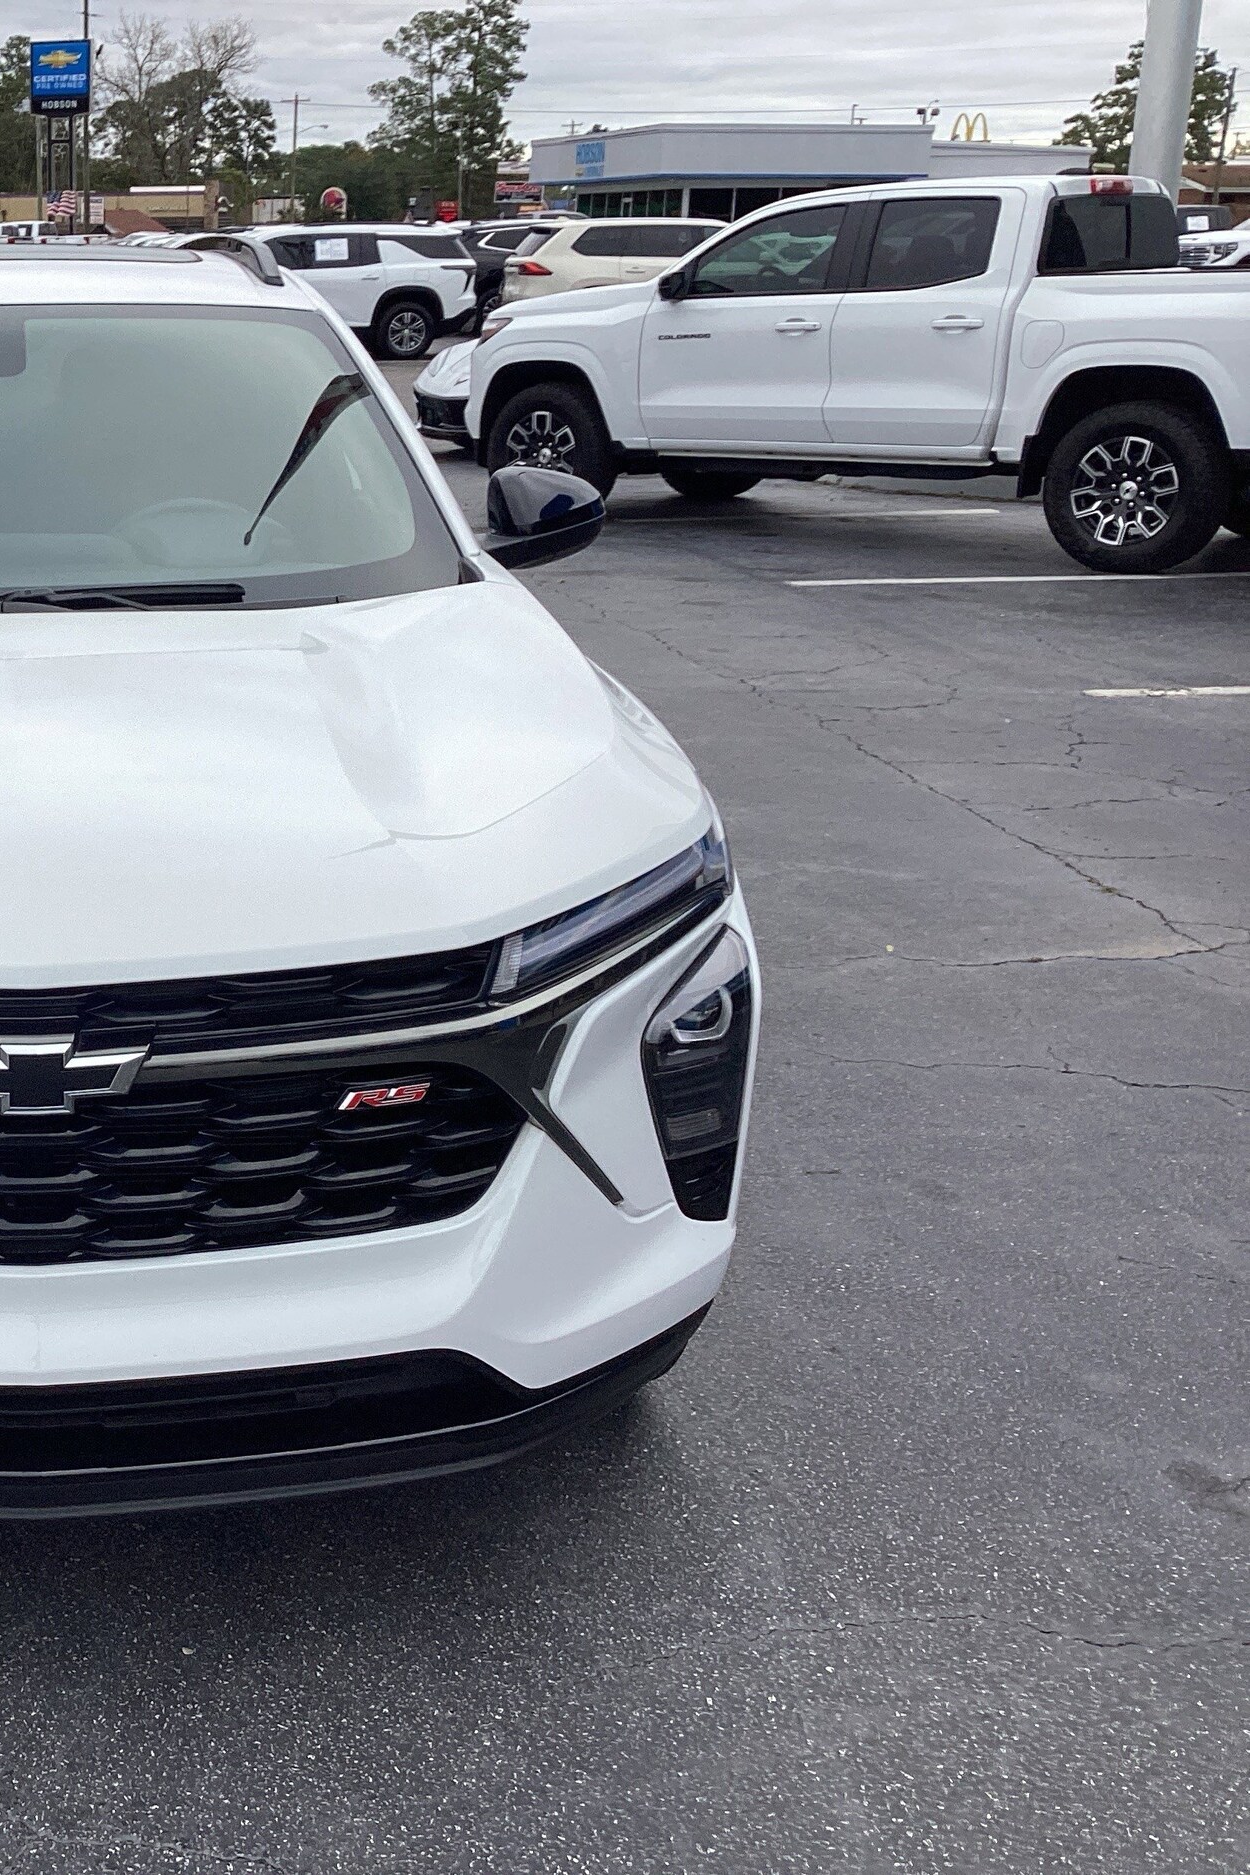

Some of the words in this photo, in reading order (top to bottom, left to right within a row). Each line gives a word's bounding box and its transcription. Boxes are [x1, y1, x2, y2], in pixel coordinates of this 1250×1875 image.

[33, 73, 87, 83] CERTIFIED
[41, 100, 78, 110] HOBSON
[337, 1082, 431, 1110] RS
